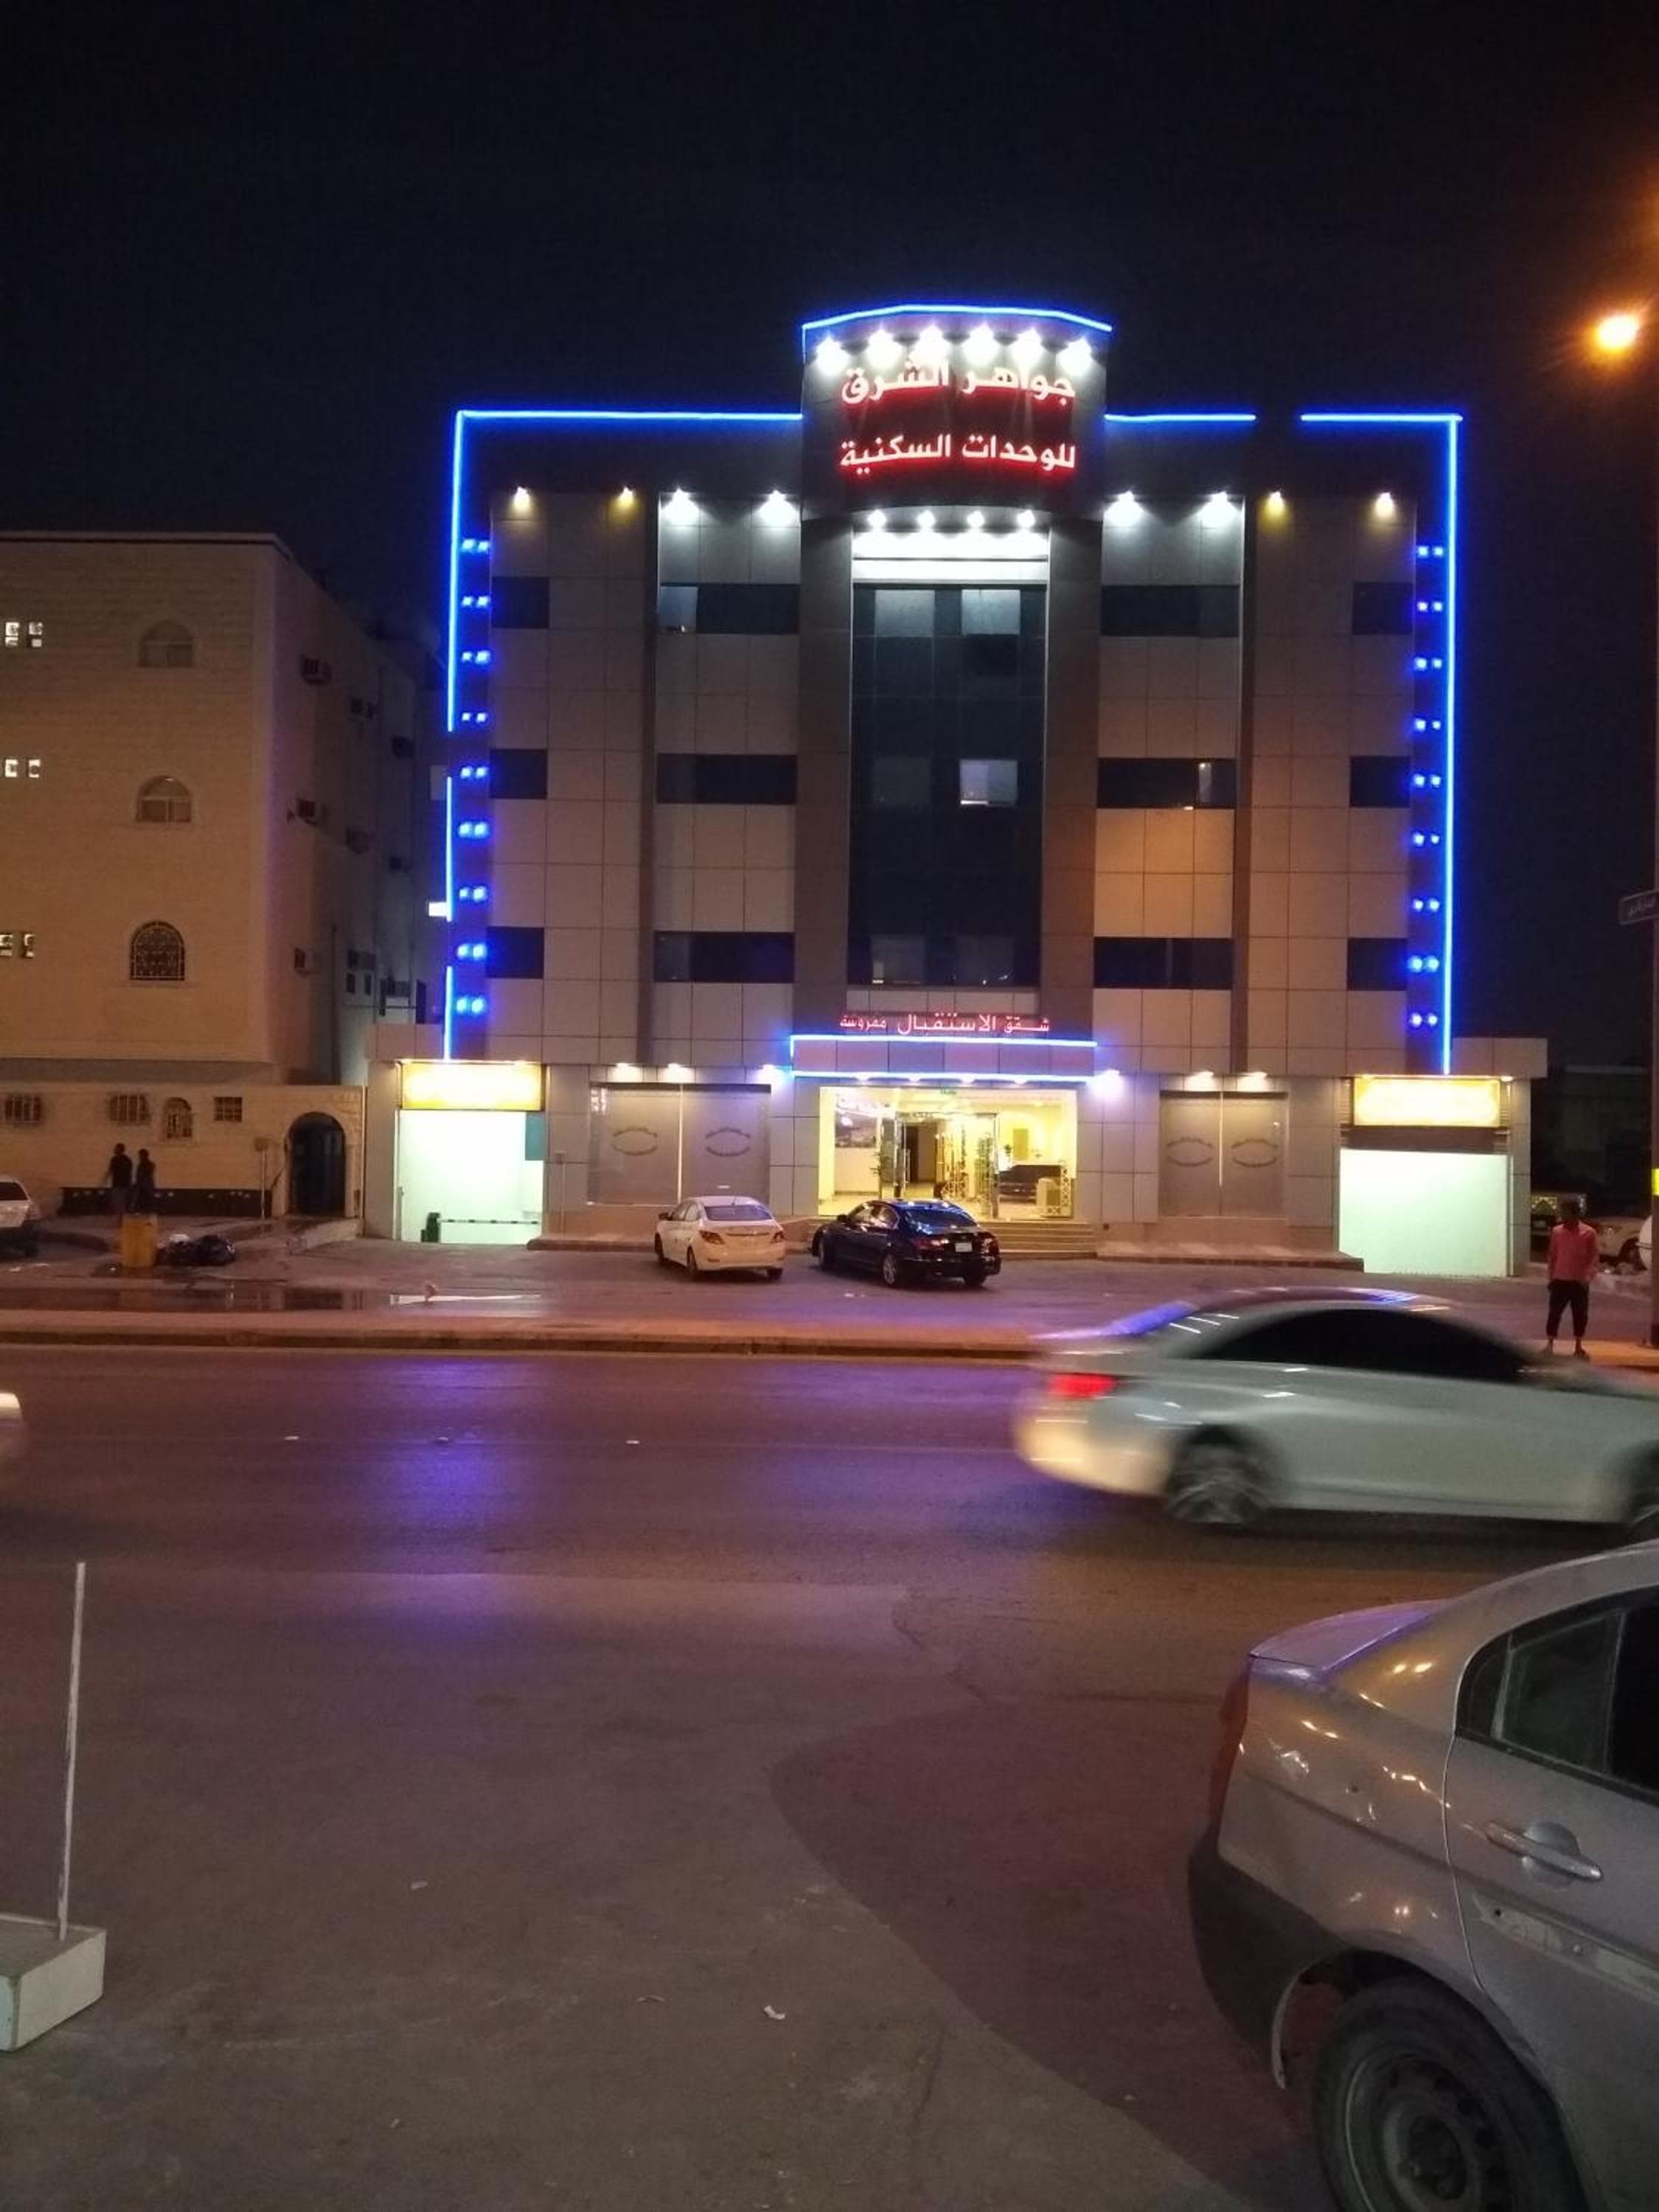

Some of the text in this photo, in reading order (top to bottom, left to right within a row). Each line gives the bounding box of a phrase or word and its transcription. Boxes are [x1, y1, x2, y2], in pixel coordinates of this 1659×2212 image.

[841, 356, 1076, 406] جواهر الشرق
[840, 434, 1077, 475] للوحدات السكنية
[897, 1012, 996, 1036] الاستقبال
[1004, 1015, 1050, 1034] شقق
